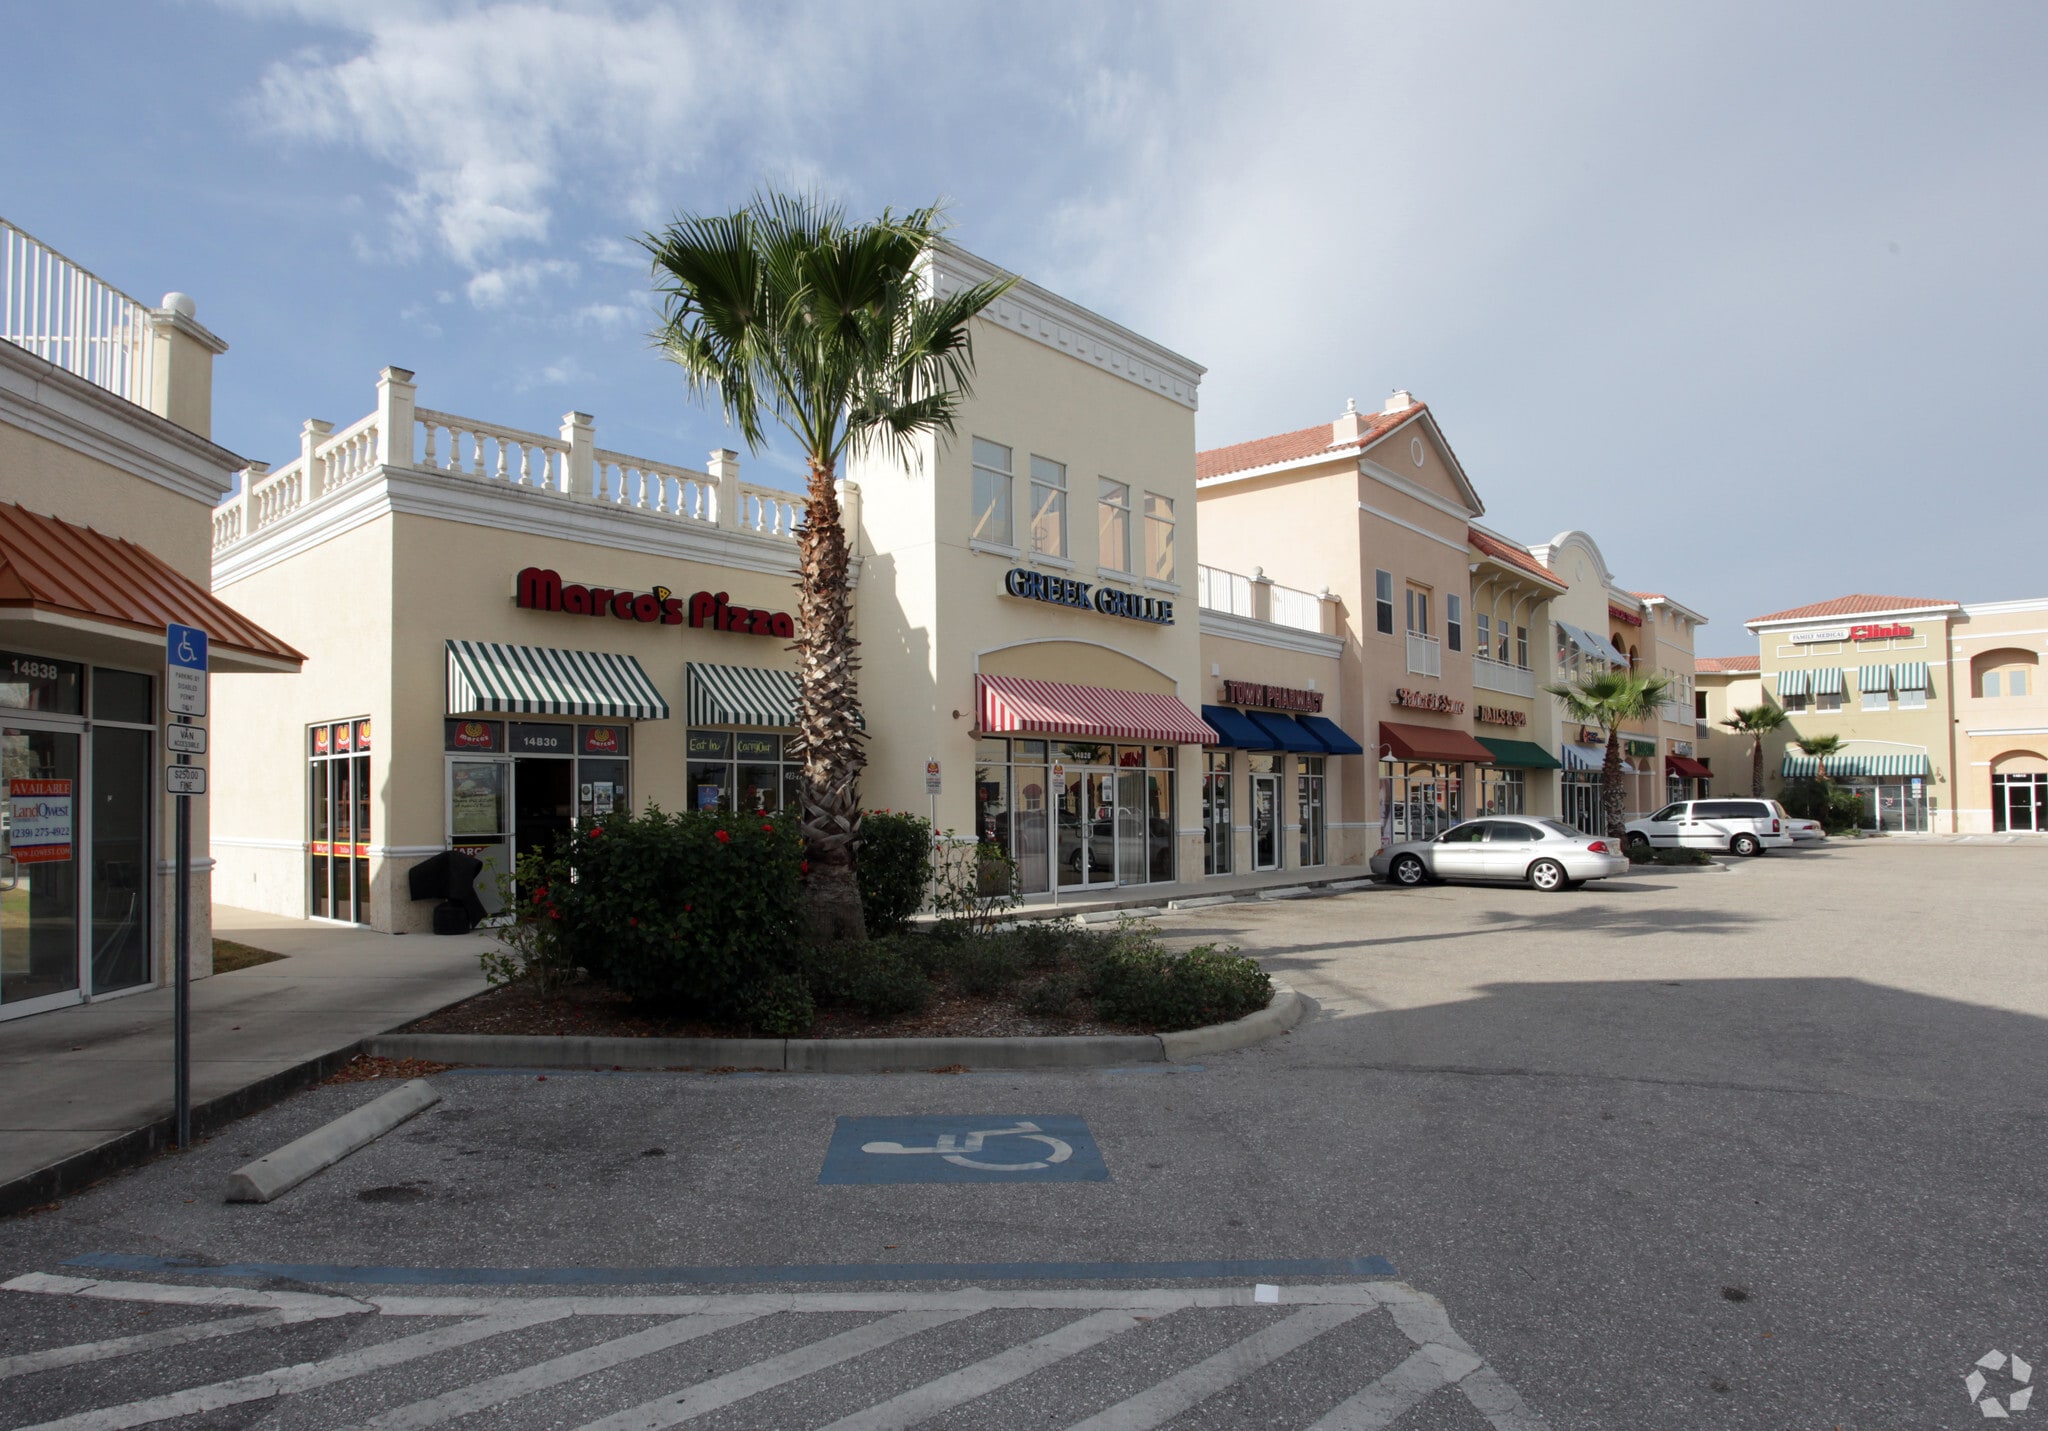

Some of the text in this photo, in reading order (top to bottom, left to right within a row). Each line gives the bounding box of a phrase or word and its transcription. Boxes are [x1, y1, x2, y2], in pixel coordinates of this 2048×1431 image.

[1005, 568, 1175, 625] GREEK GRILLE
[517, 567, 794, 638] Marco's Pizza
[1792, 631, 1845, 641] FAMILY MEDICAL
[1850, 622, 1914, 640] Clinic
[11, 659, 57, 680] 14838
[175, 671, 193, 681] PARKING
[177, 682, 198, 692] DISABLED
[180, 693, 195, 702] PERMIT
[1224, 680, 1324, 712] TOWN PHARMACY
[180, 730, 194, 740] VAN
[523, 736, 558, 747] 14830
[689, 739, 707, 751] Eat
[174, 770, 199, 780] $250.00
[13, 783, 70, 795] AVAILABLE
[180, 781, 193, 791] FINE
[12, 826, 70, 839] (239) 275-4922
